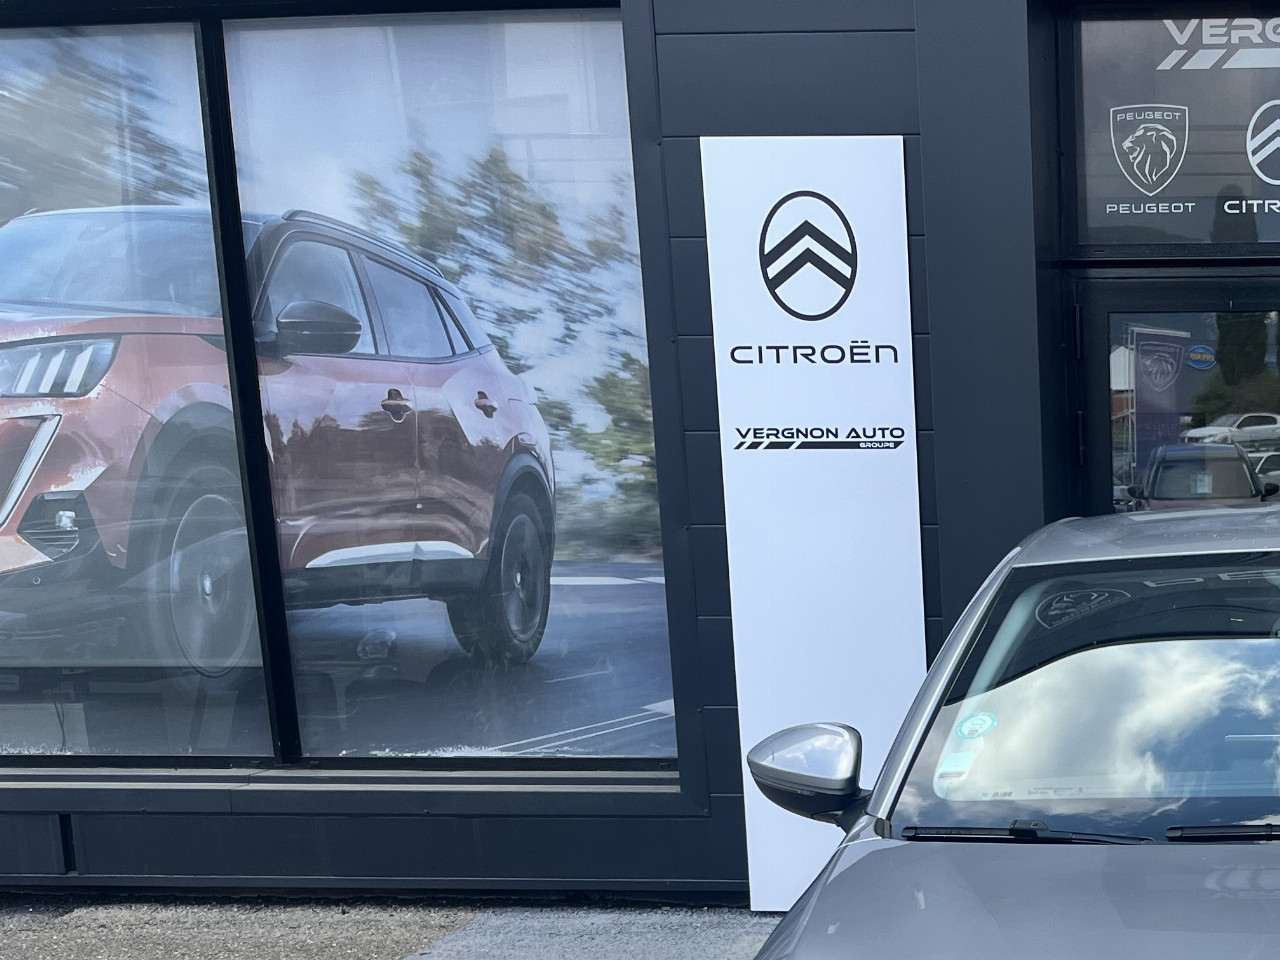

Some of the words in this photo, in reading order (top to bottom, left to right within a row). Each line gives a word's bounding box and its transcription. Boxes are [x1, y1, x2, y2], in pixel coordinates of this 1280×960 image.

[1116, 109, 1182, 122] PEUGEOT
[1105, 202, 1196, 214] PEUGEOT
[735, 427, 839, 440] VERGNON
[845, 427, 905, 439] AUTO
[858, 440, 895, 448] GROUPE
